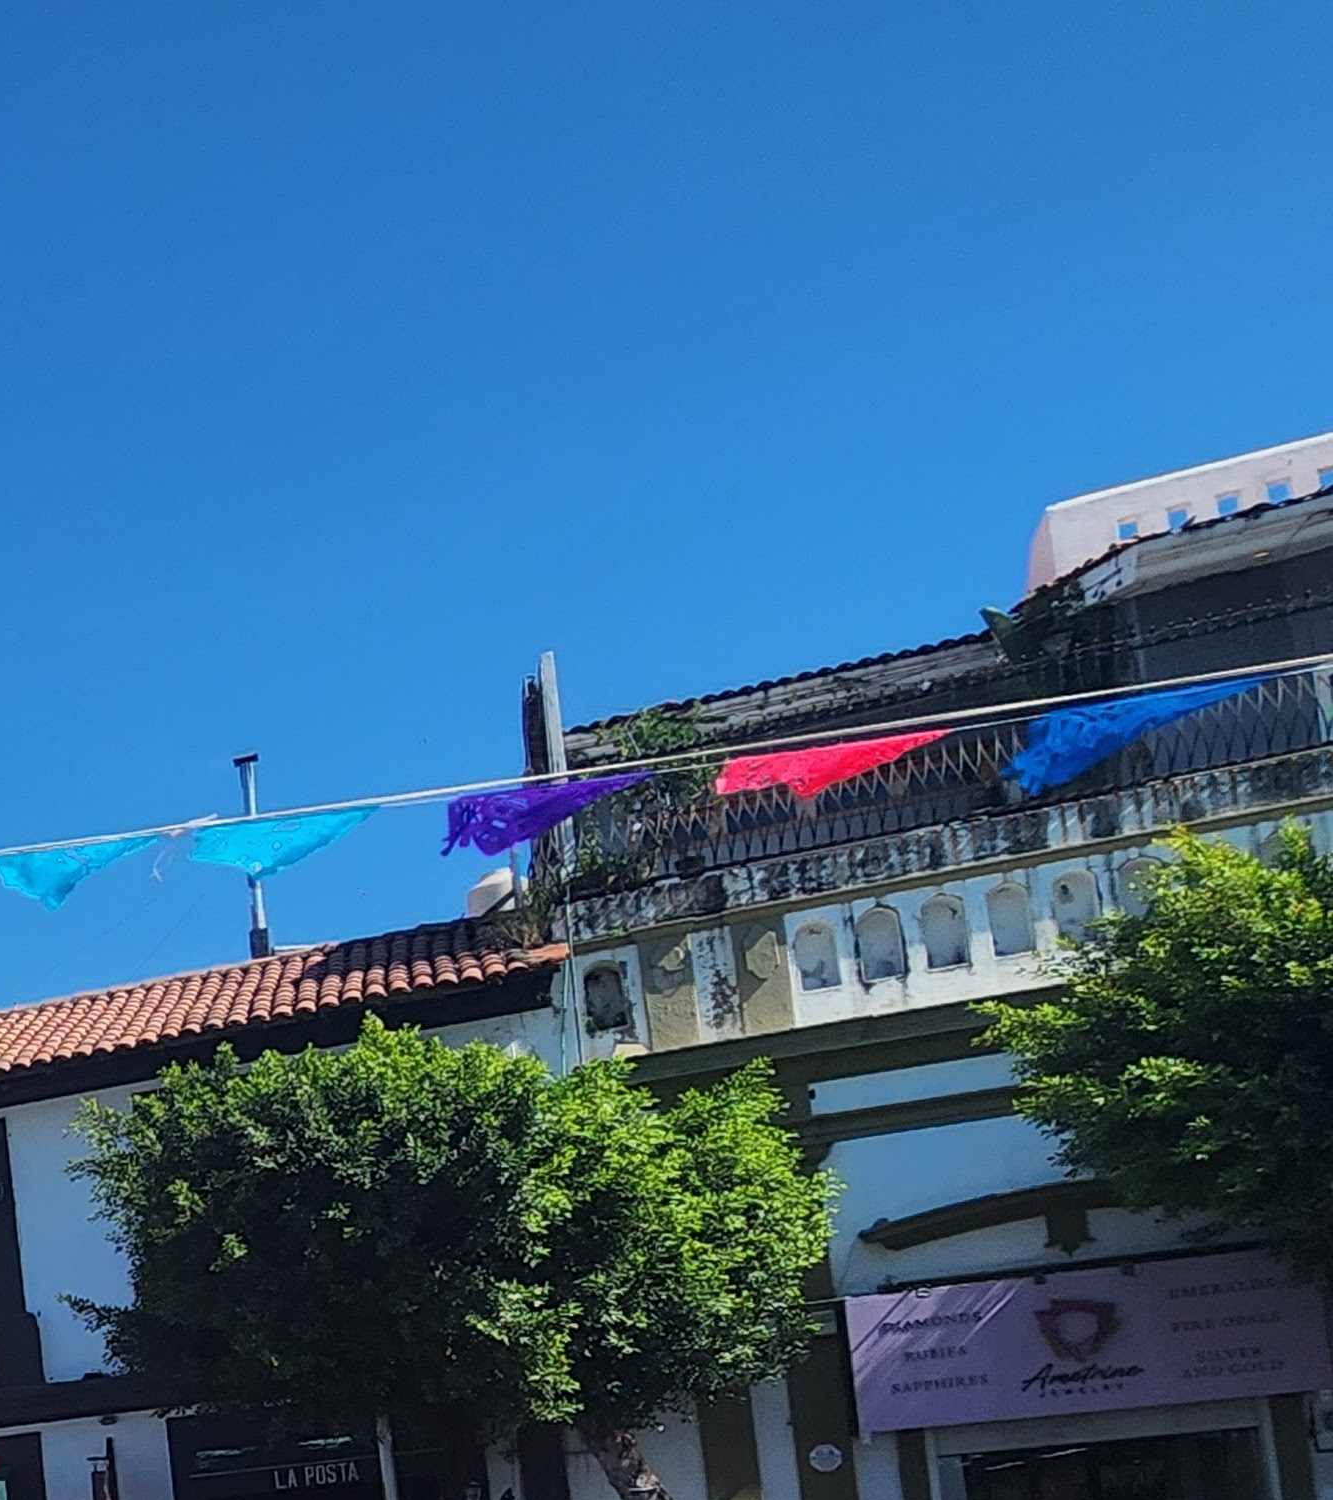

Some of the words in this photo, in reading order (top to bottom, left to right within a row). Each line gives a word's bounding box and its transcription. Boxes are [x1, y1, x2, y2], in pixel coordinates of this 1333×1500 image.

[879, 1311, 983, 1336] DIAMONDS
[903, 1345, 967, 1361] RUBIES
[890, 1374, 989, 1395] SAPPHIRES
[273, 1468, 298, 1489] LA
[303, 1461, 360, 1487] POSTA
